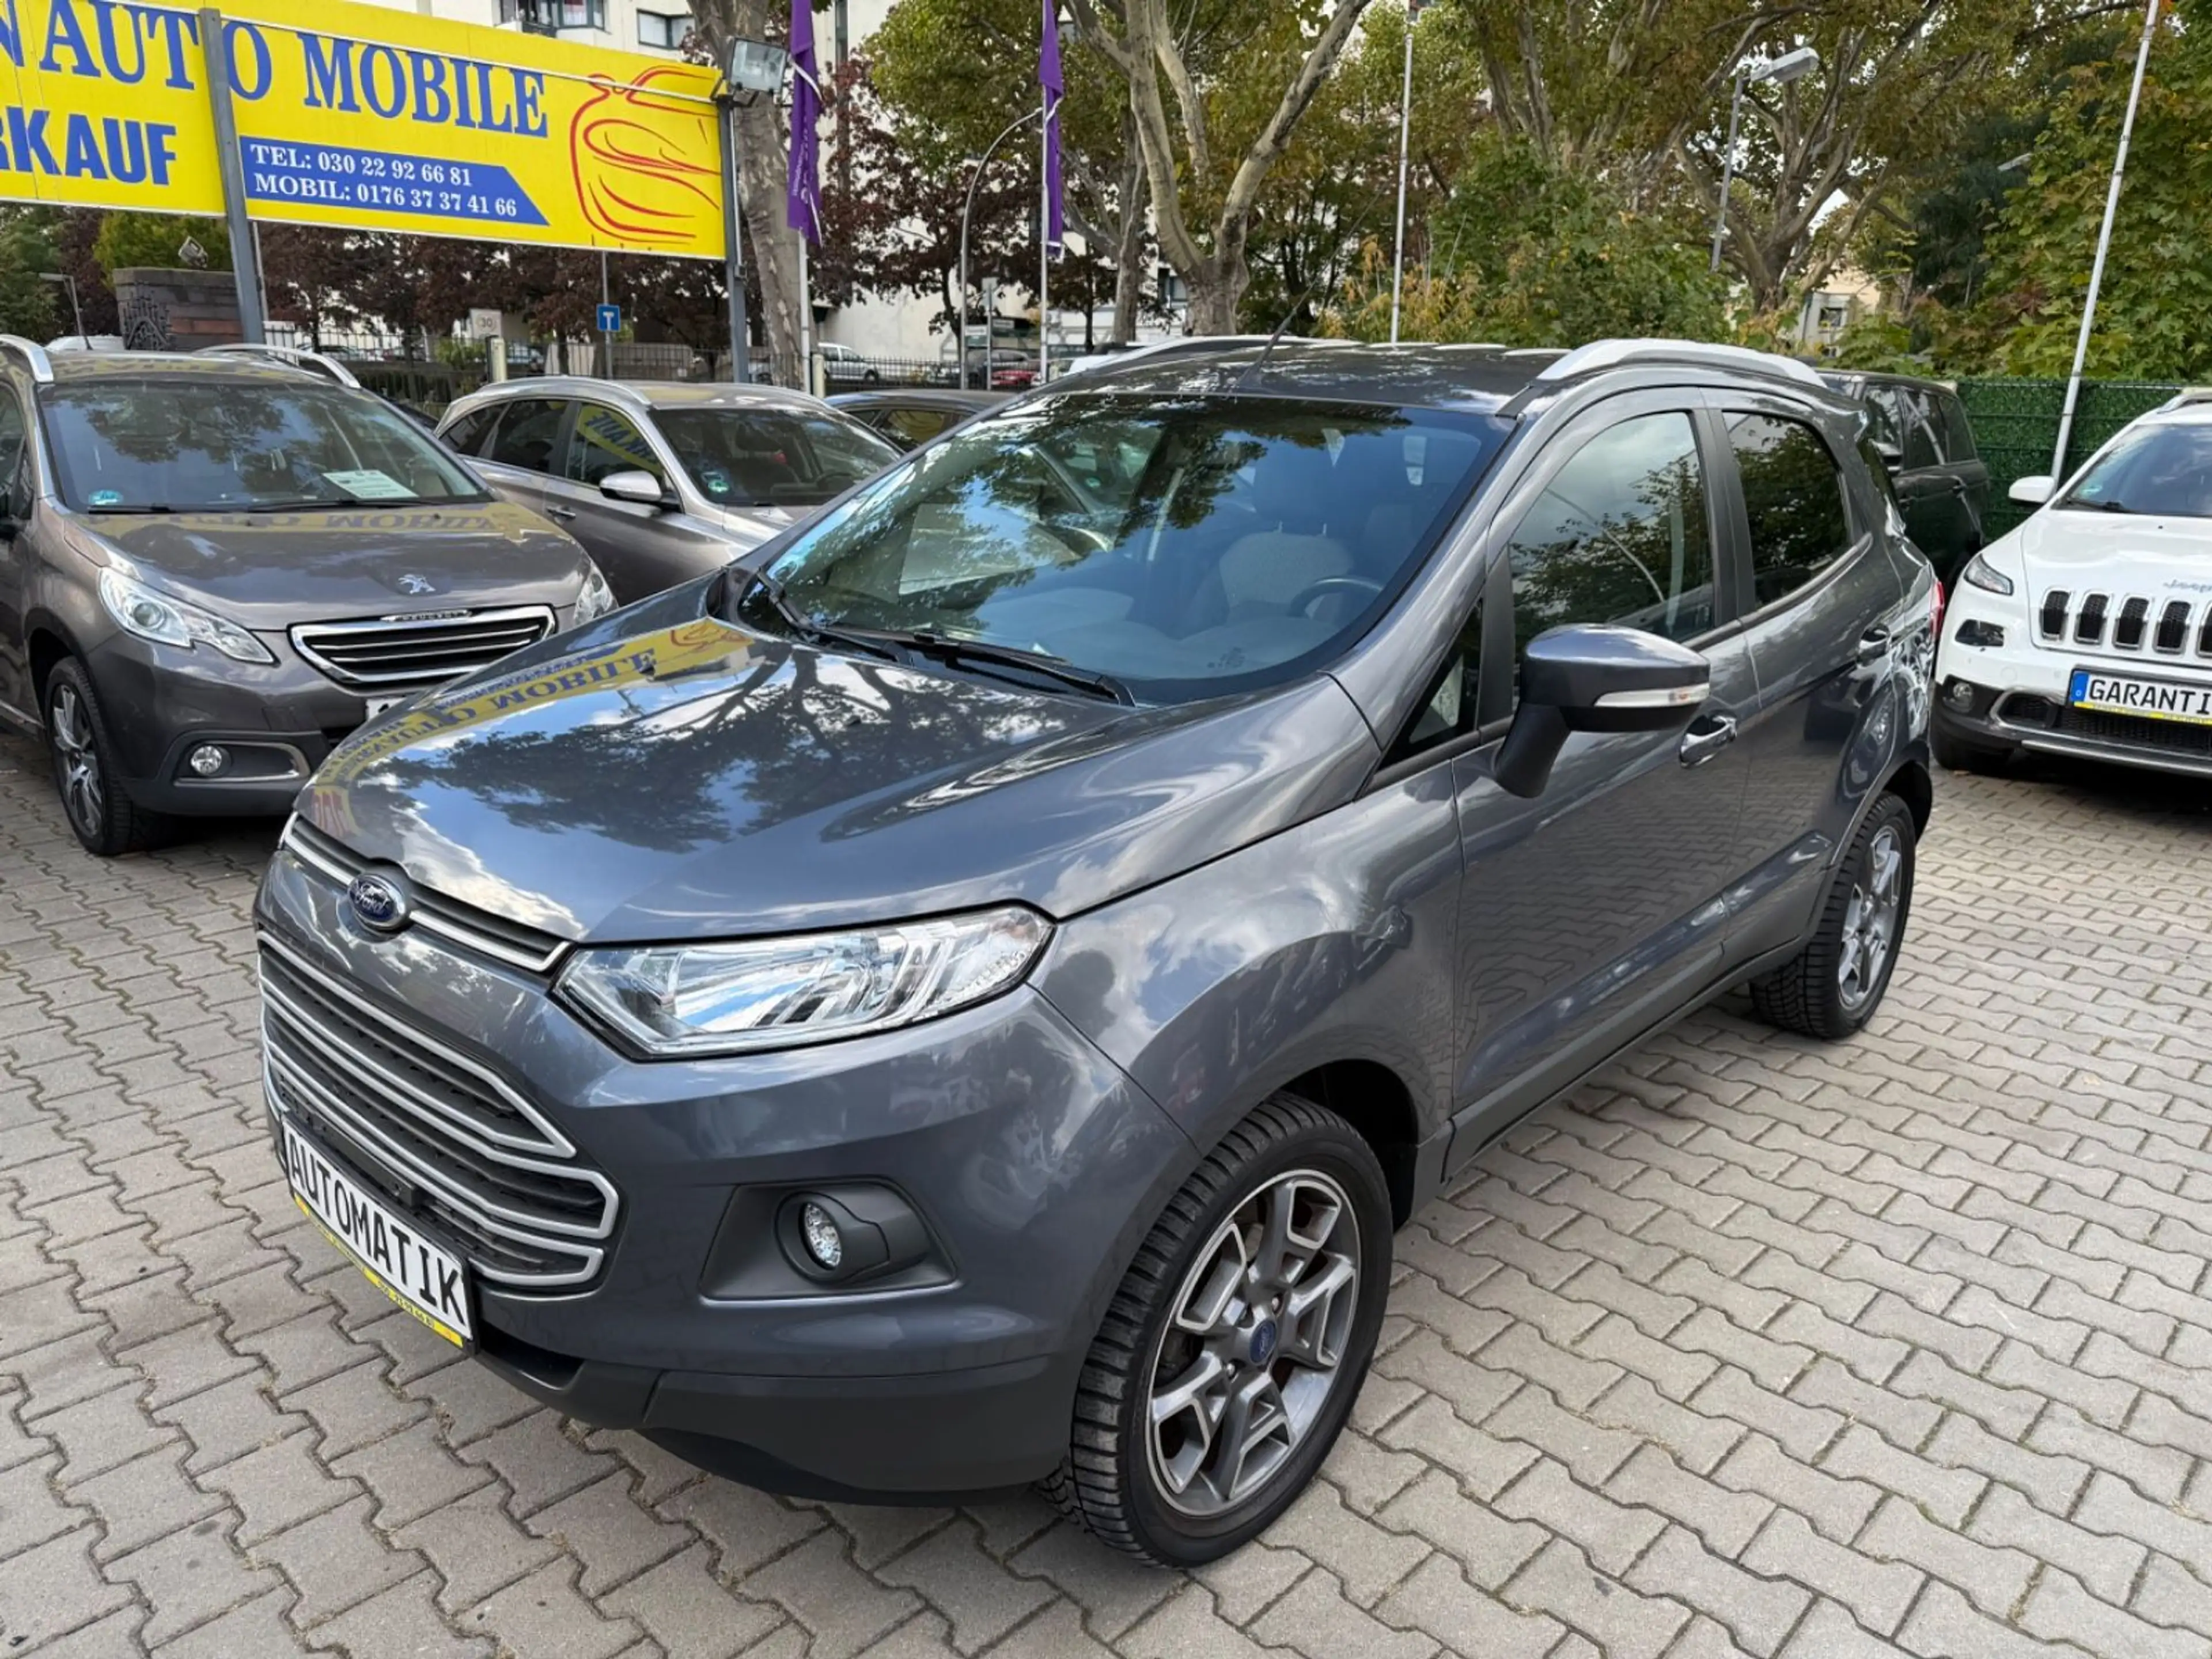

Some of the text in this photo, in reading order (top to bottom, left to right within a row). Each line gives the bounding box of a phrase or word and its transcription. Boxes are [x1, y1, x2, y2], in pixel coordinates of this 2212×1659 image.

[39, 0, 272, 100] AUTO
[296, 31, 548, 138] MOBILE
[0, 105, 176, 185] KAUF
[250, 144, 472, 187] TEL: 030 22 92 66 81
[254, 173, 517, 217] MOBIL: 0176 37 37 41 66
[2089, 679, 2211, 715] GARANTI
[289, 1132, 467, 1327] AUTOMATIK
